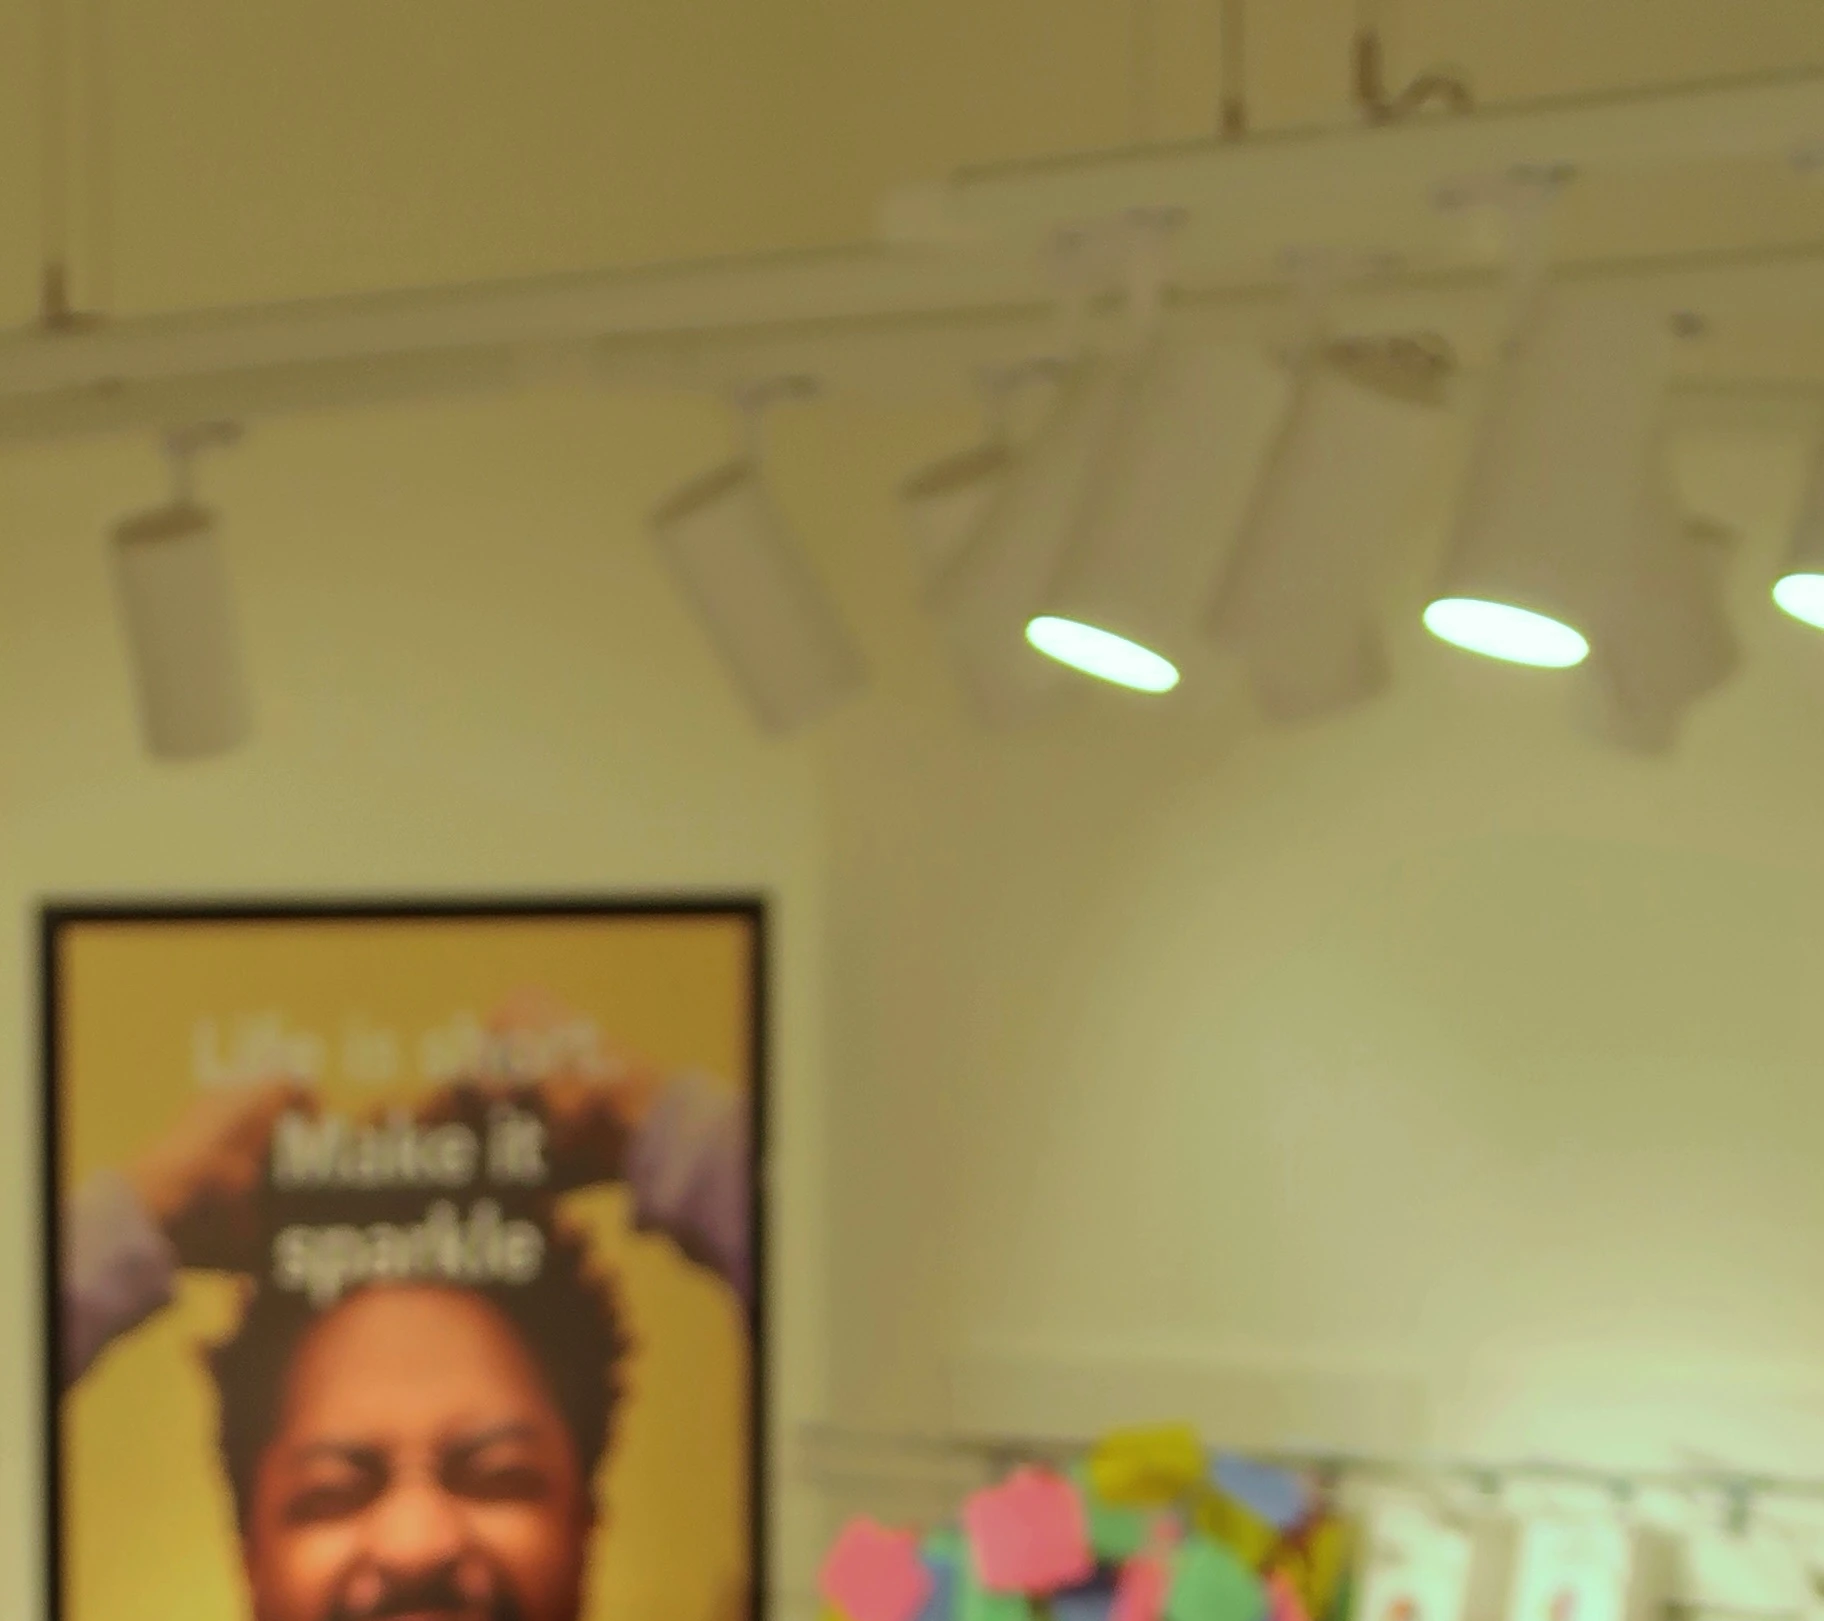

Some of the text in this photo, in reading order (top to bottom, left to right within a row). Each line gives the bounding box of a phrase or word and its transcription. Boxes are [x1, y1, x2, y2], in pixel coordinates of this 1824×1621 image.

[271, 1102, 549, 1189] Make it
[272, 1199, 547, 1308] sparkle
